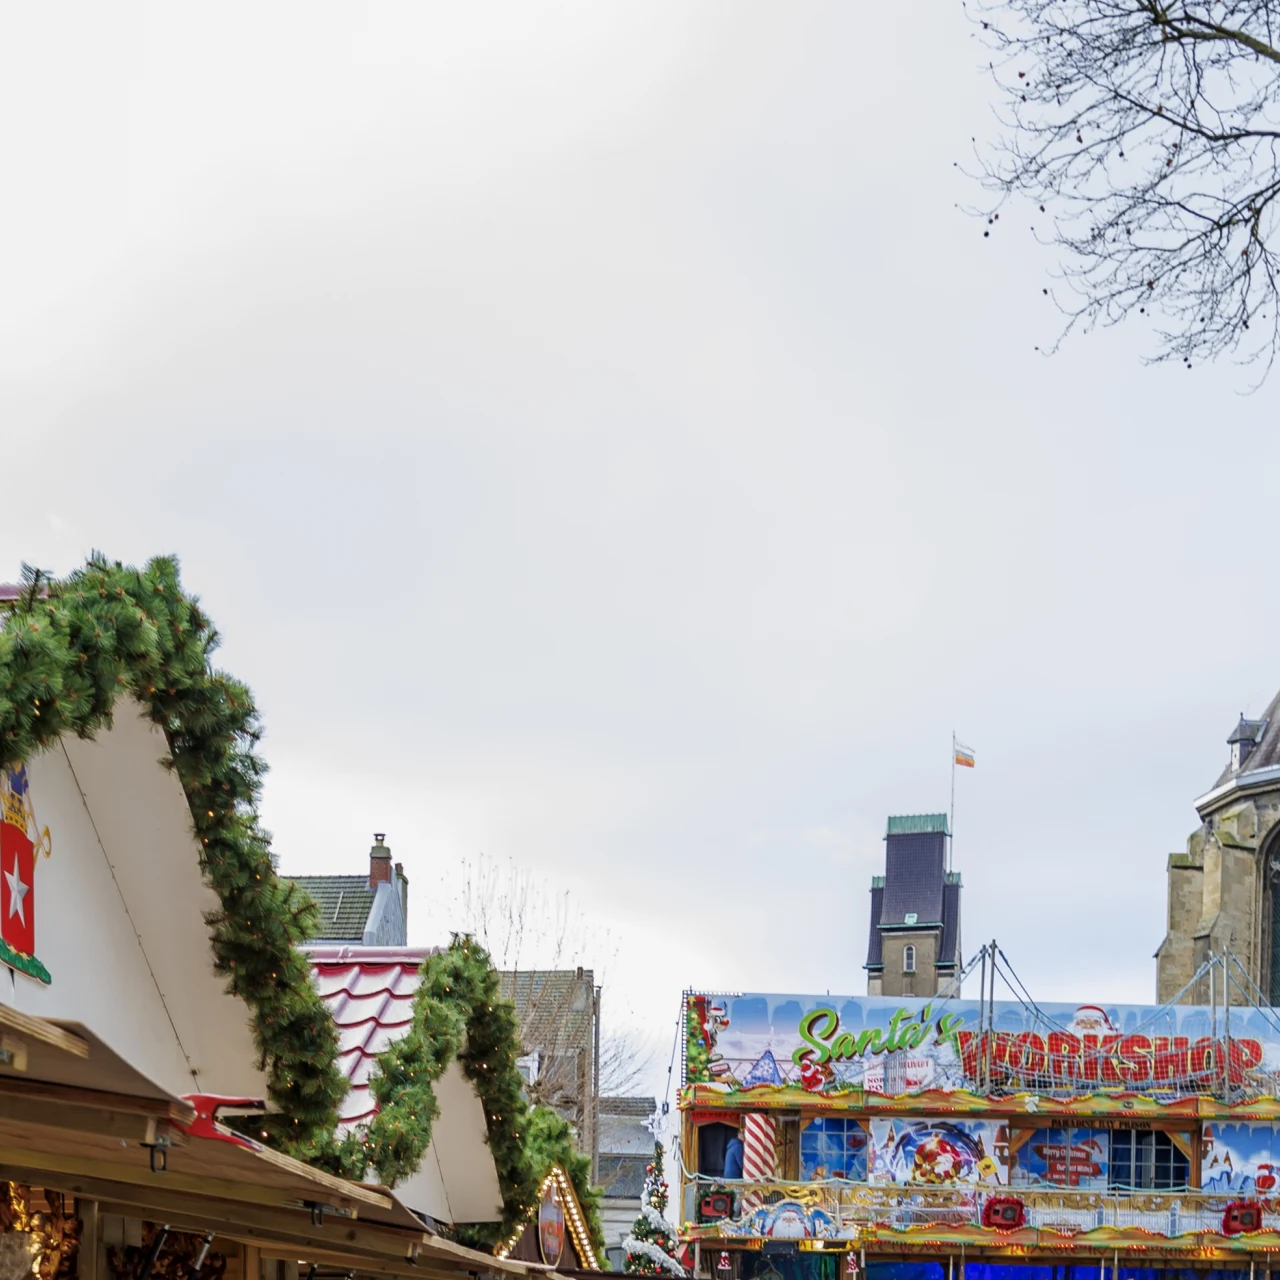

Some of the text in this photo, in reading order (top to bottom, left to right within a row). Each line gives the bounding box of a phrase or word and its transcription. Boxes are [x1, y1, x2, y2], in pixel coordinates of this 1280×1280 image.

[792, 1003, 1263, 1085] Santa's WORKSHOP
[1120, 1120, 1152, 1129] PRISON
